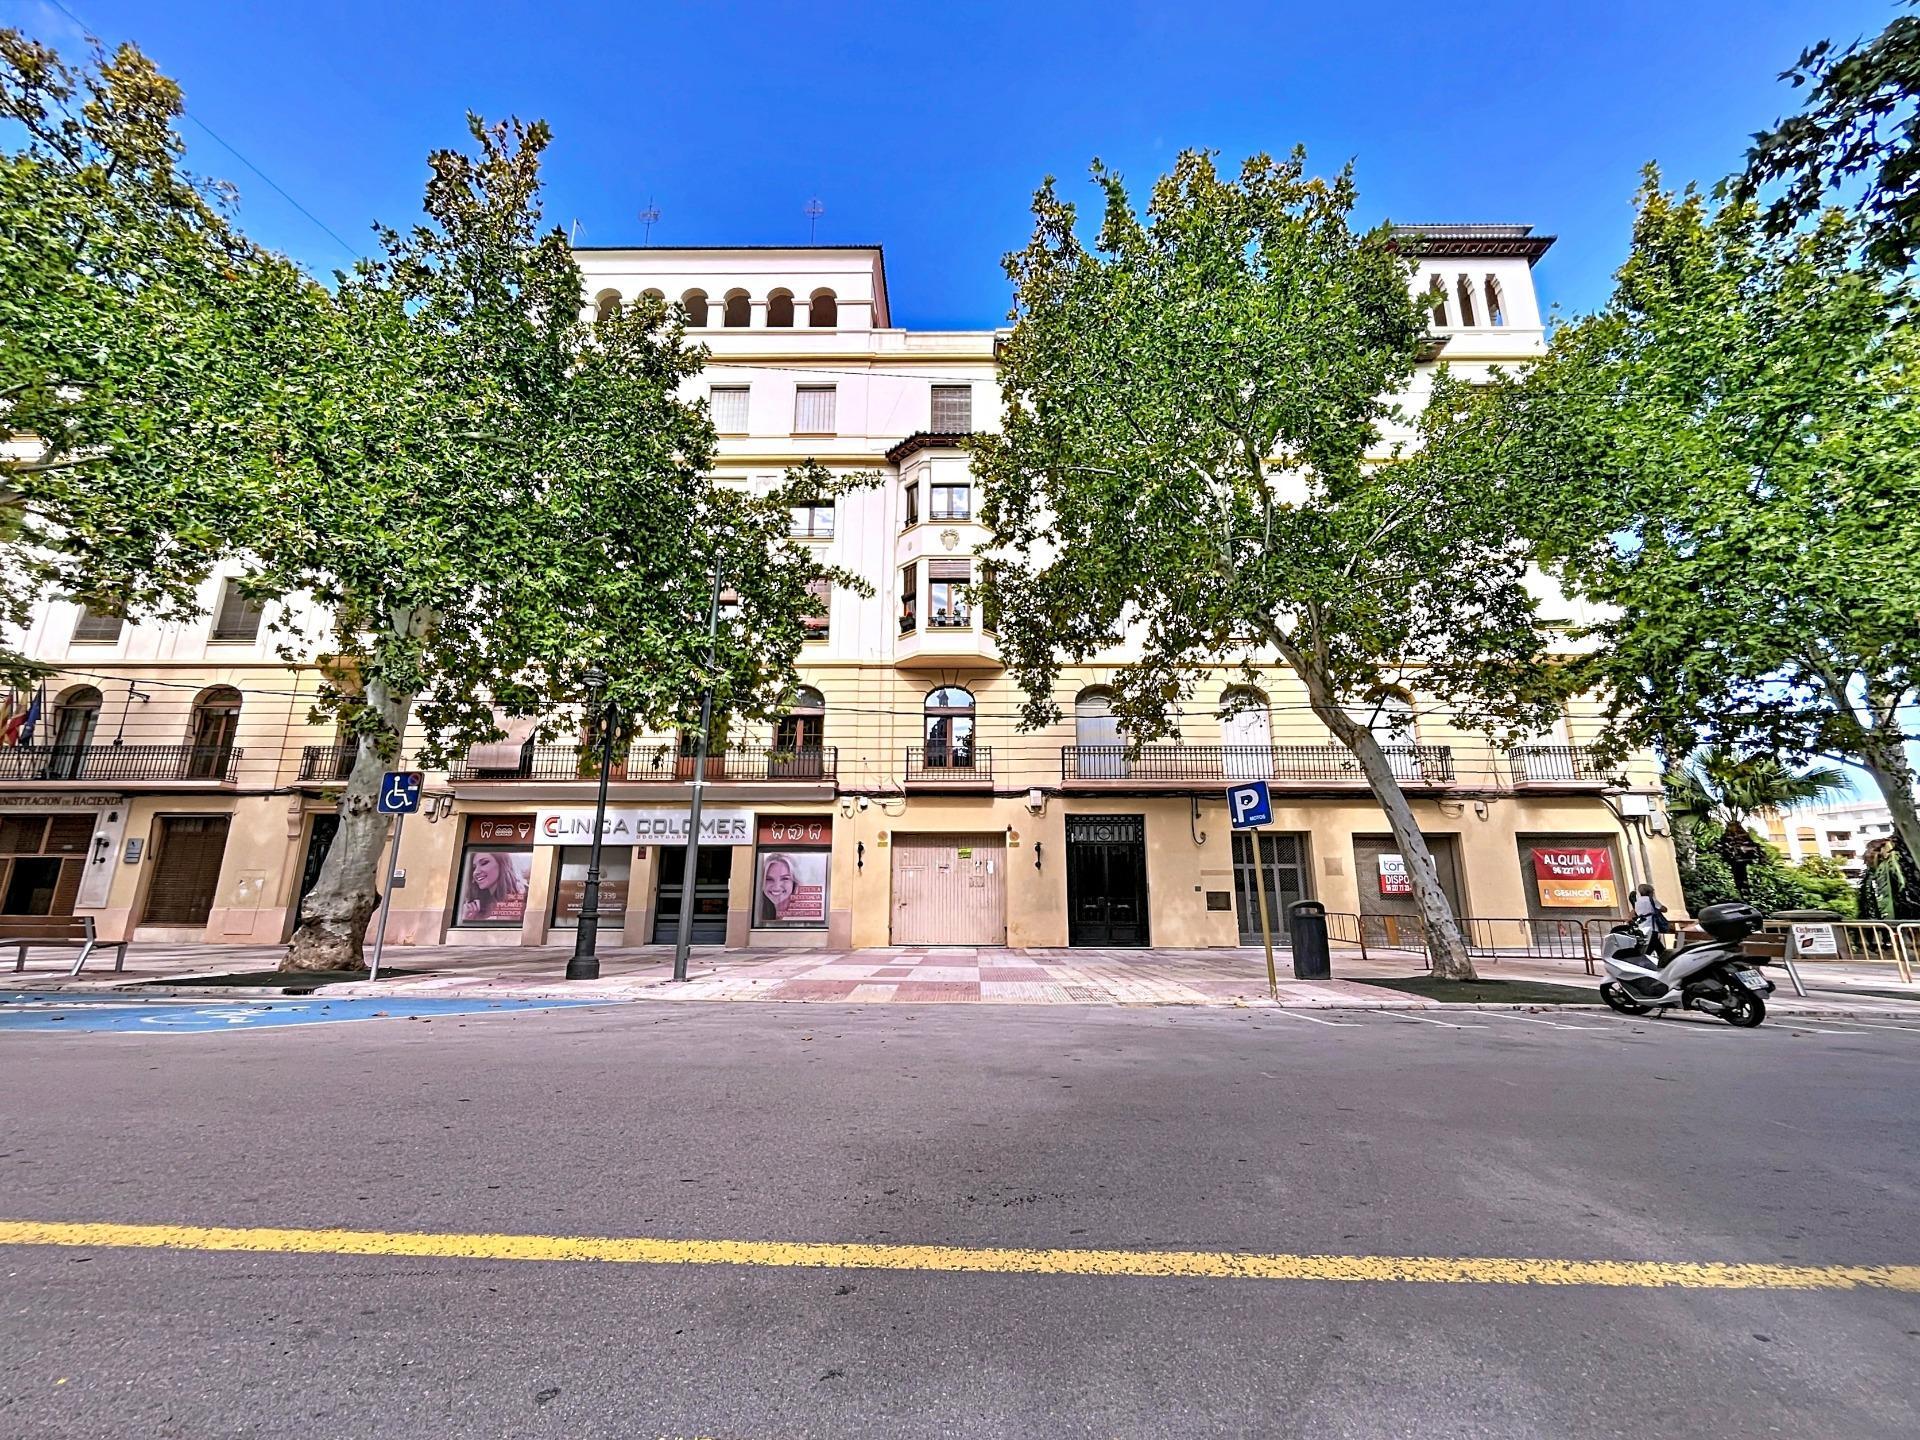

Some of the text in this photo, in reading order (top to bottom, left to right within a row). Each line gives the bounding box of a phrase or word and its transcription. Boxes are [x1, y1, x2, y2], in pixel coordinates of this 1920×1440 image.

[72, 796, 124, 806] HACIENDA
[1234, 789, 1260, 823] P
[636, 818, 747, 834] COLOMER
[1543, 854, 1593, 866] ALQUILA
[1552, 866, 1562, 874] 96
[1385, 875, 1410, 885] DISPO
